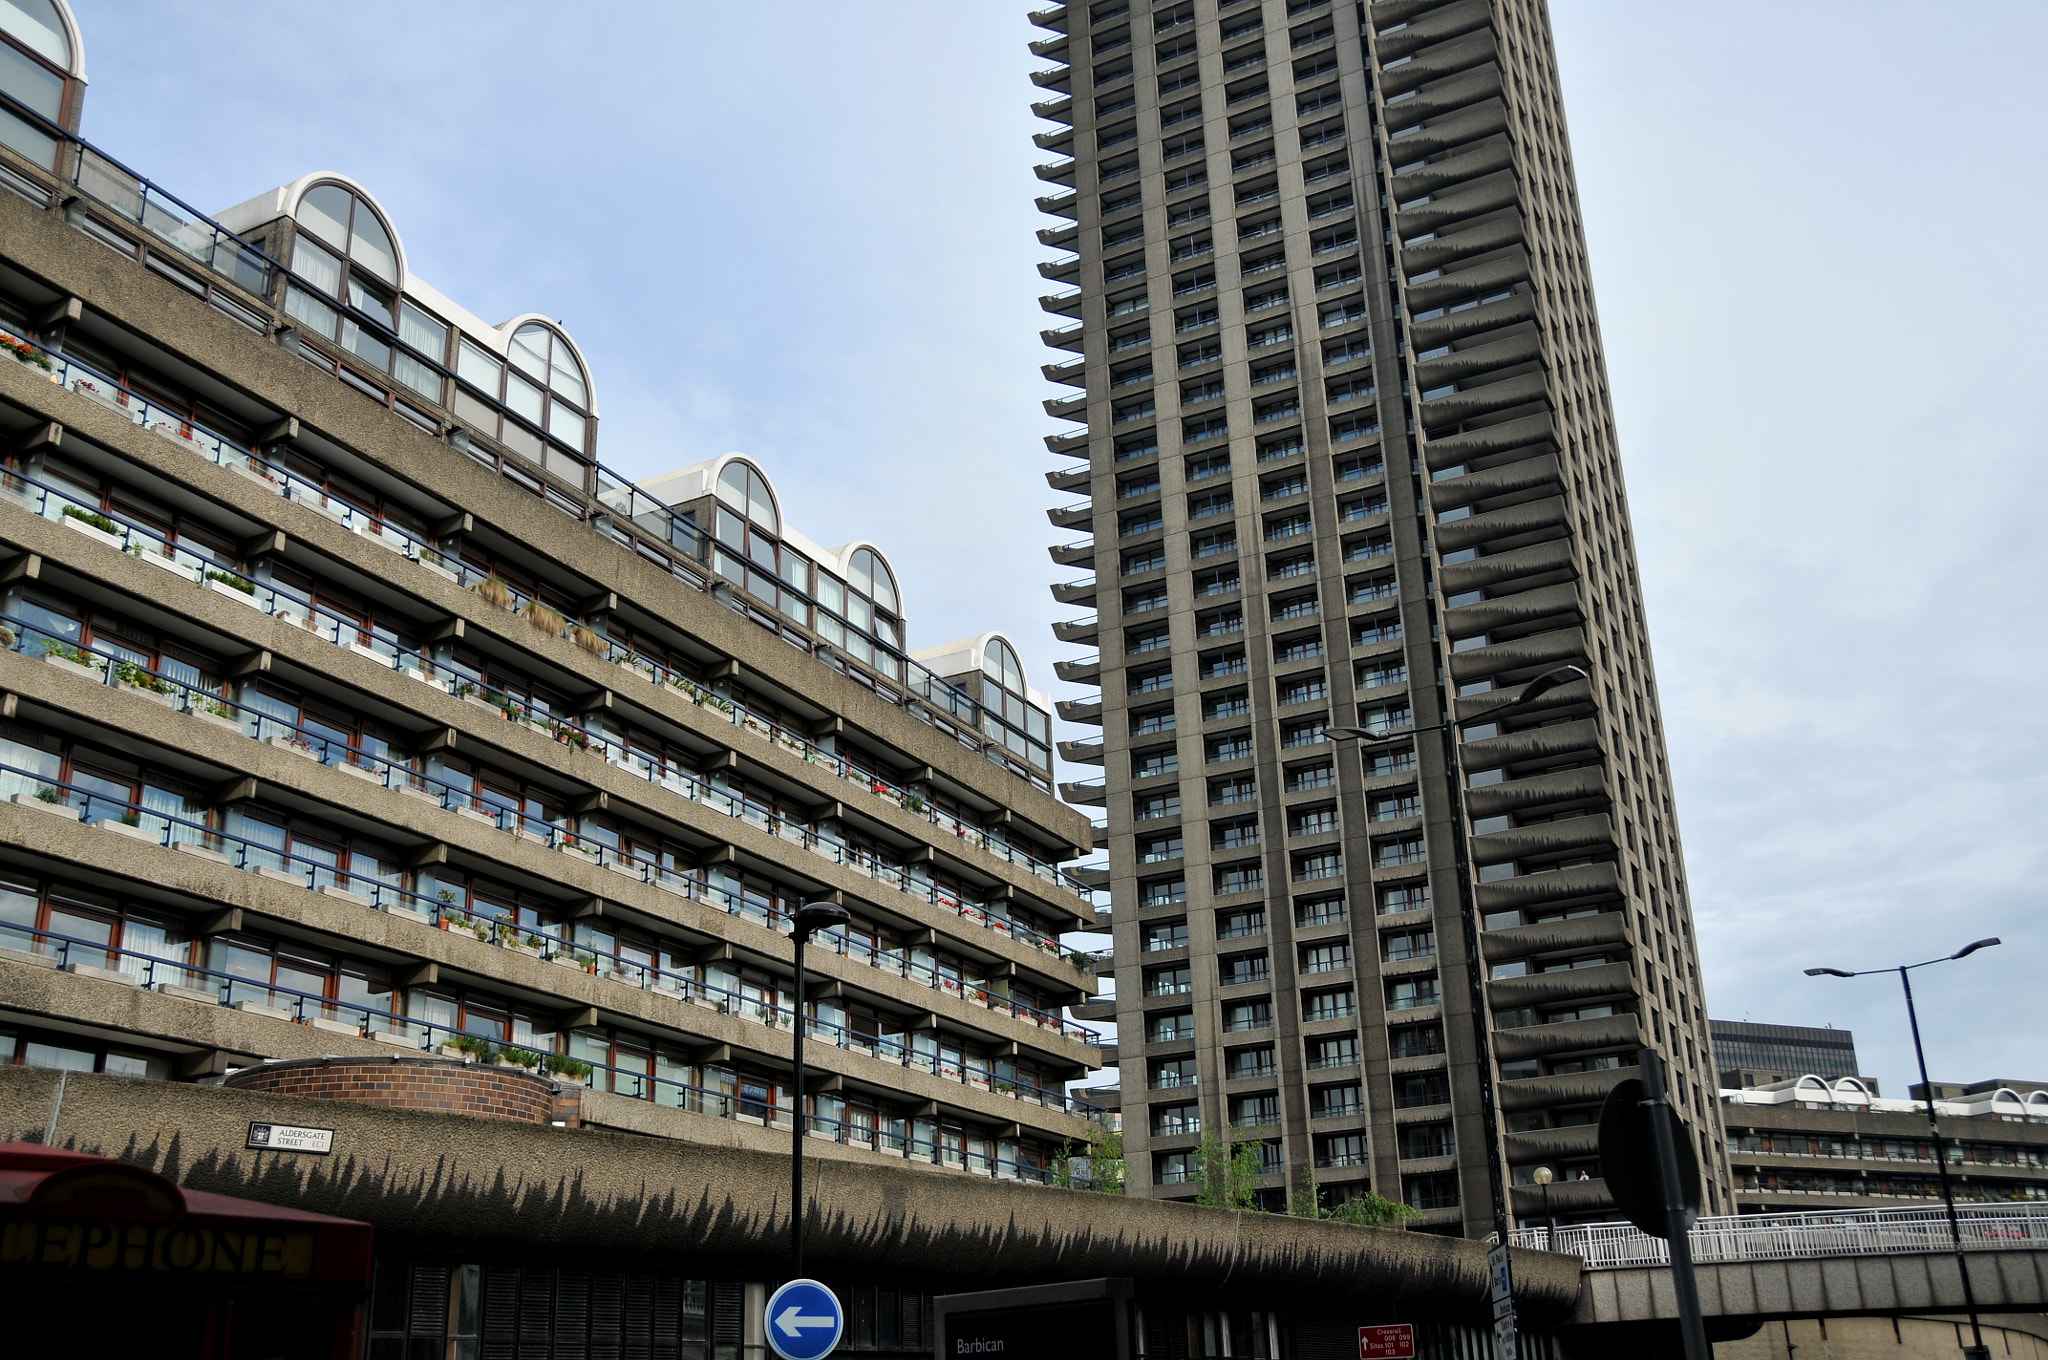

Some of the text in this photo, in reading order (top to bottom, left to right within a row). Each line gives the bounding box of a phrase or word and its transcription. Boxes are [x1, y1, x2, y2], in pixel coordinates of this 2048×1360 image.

[279, 1129, 325, 1140] ALDERSGATE
[277, 1138, 303, 1146] STREET
[957, 1337, 1004, 1354] Barbican
